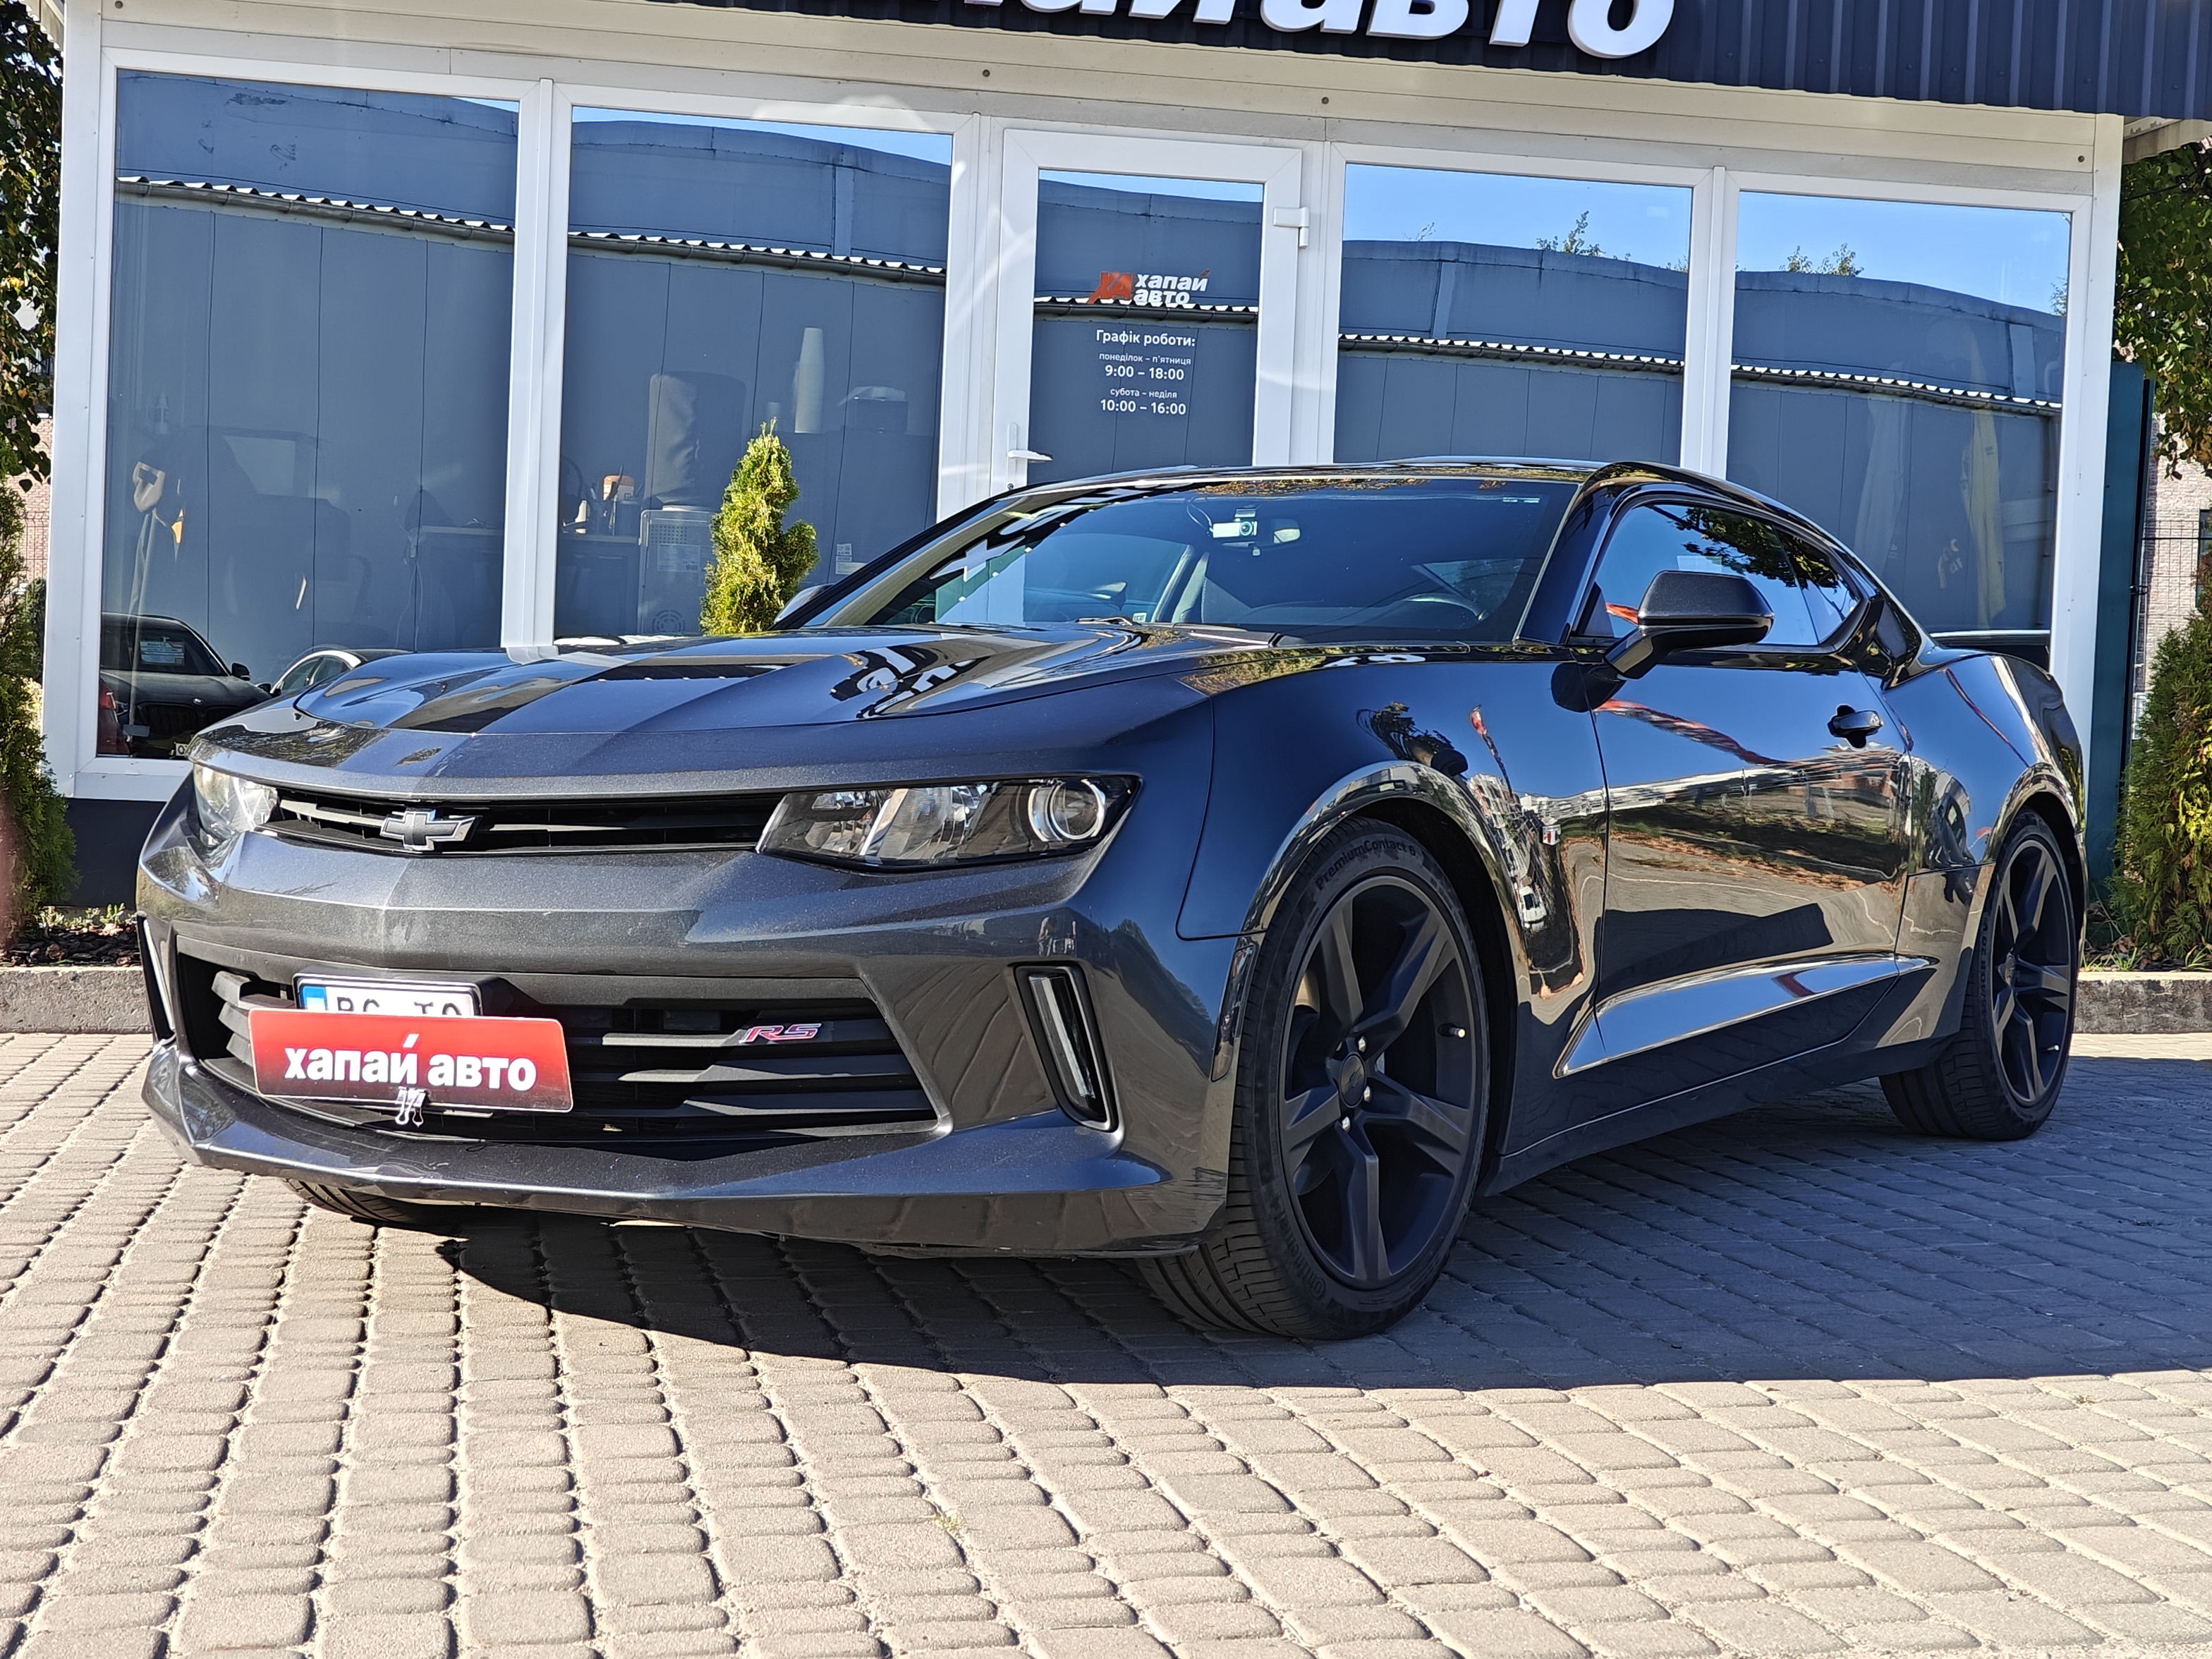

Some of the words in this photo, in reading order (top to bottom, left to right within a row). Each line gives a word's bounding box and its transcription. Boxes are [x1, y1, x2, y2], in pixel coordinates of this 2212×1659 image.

[1133, 288, 1190, 305] авто
[1096, 329, 1141, 345] Графік
[1143, 333, 1196, 347] роботи:
[1099, 353, 1143, 363] понеділок
[1105, 365, 1134, 377] 9:00
[1149, 367, 1185, 381] 18:00
[1110, 388, 1141, 397] субота
[1148, 390, 1178, 399] неділя
[1100, 399, 1137, 413] 10:00
[1150, 402, 1187, 415] 16:00
[1315, 838, 1408, 890] PremiumContact
[739, 1023, 822, 1043] RS
[427, 1054, 537, 1091] авто
